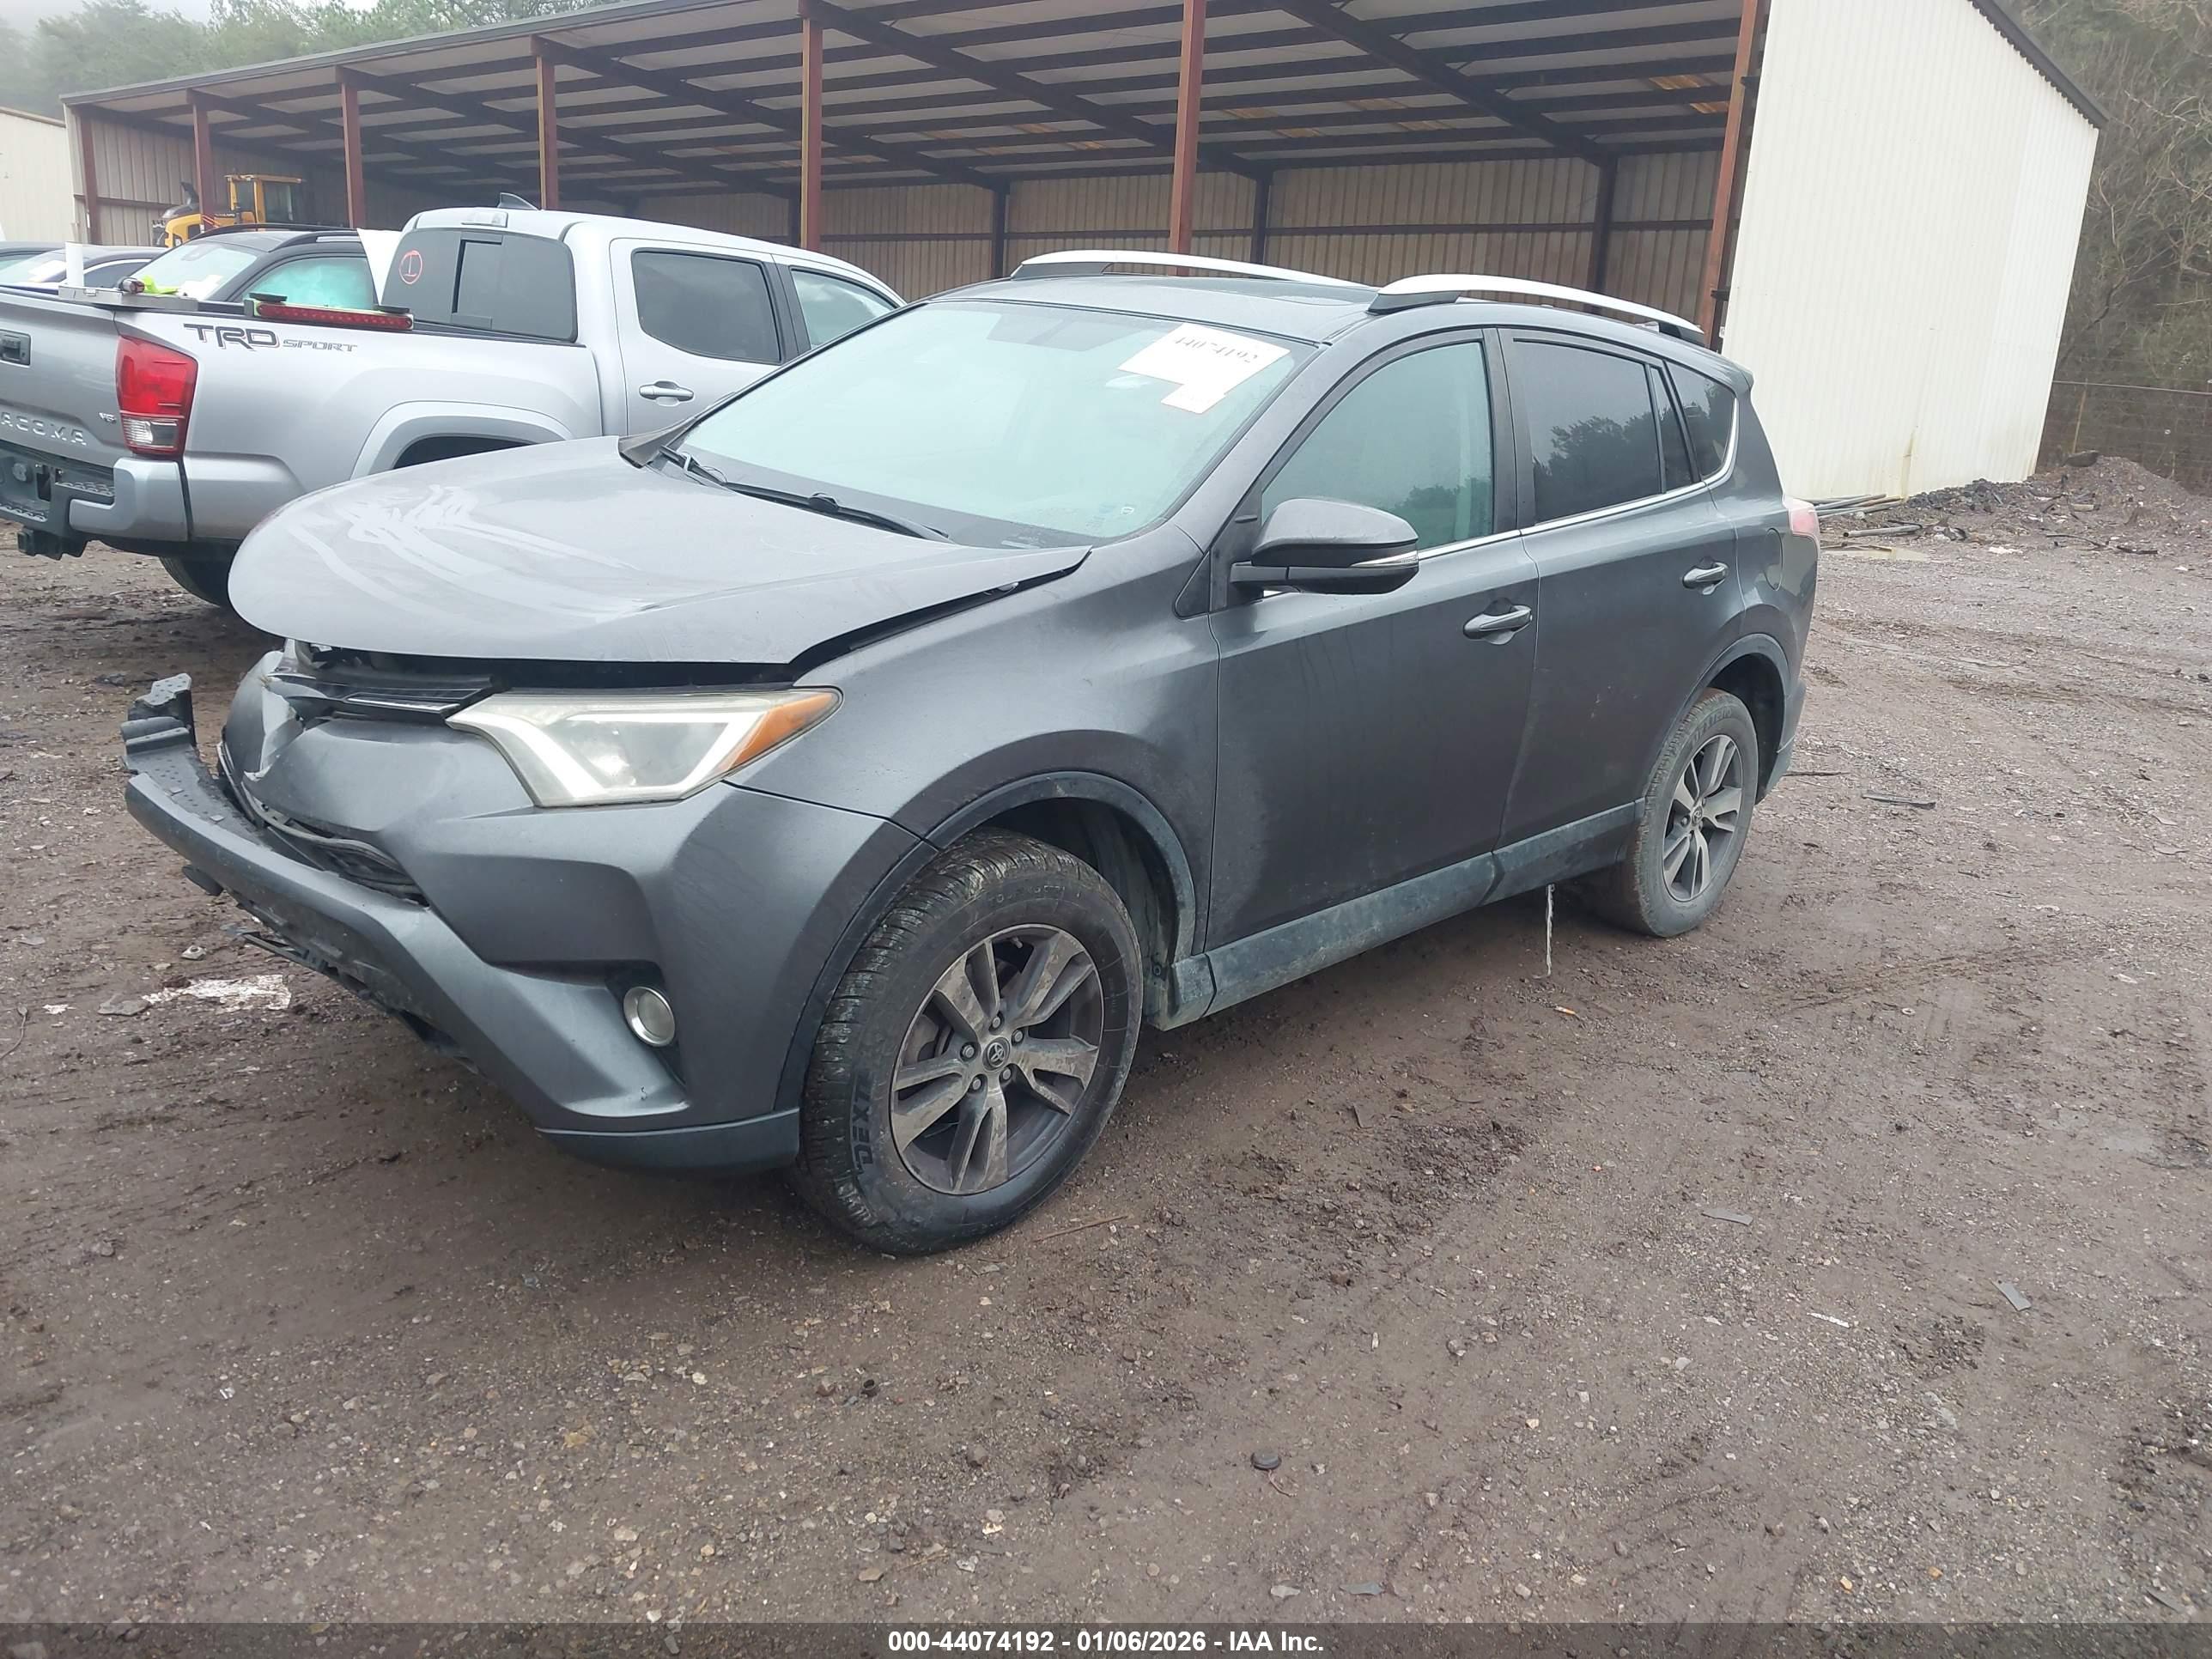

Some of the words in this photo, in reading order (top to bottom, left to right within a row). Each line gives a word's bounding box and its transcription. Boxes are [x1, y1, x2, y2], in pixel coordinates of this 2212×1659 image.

[183, 323, 279, 351] TRD
[283, 338, 358, 352] SPORT
[0, 412, 87, 446] ACOMA
